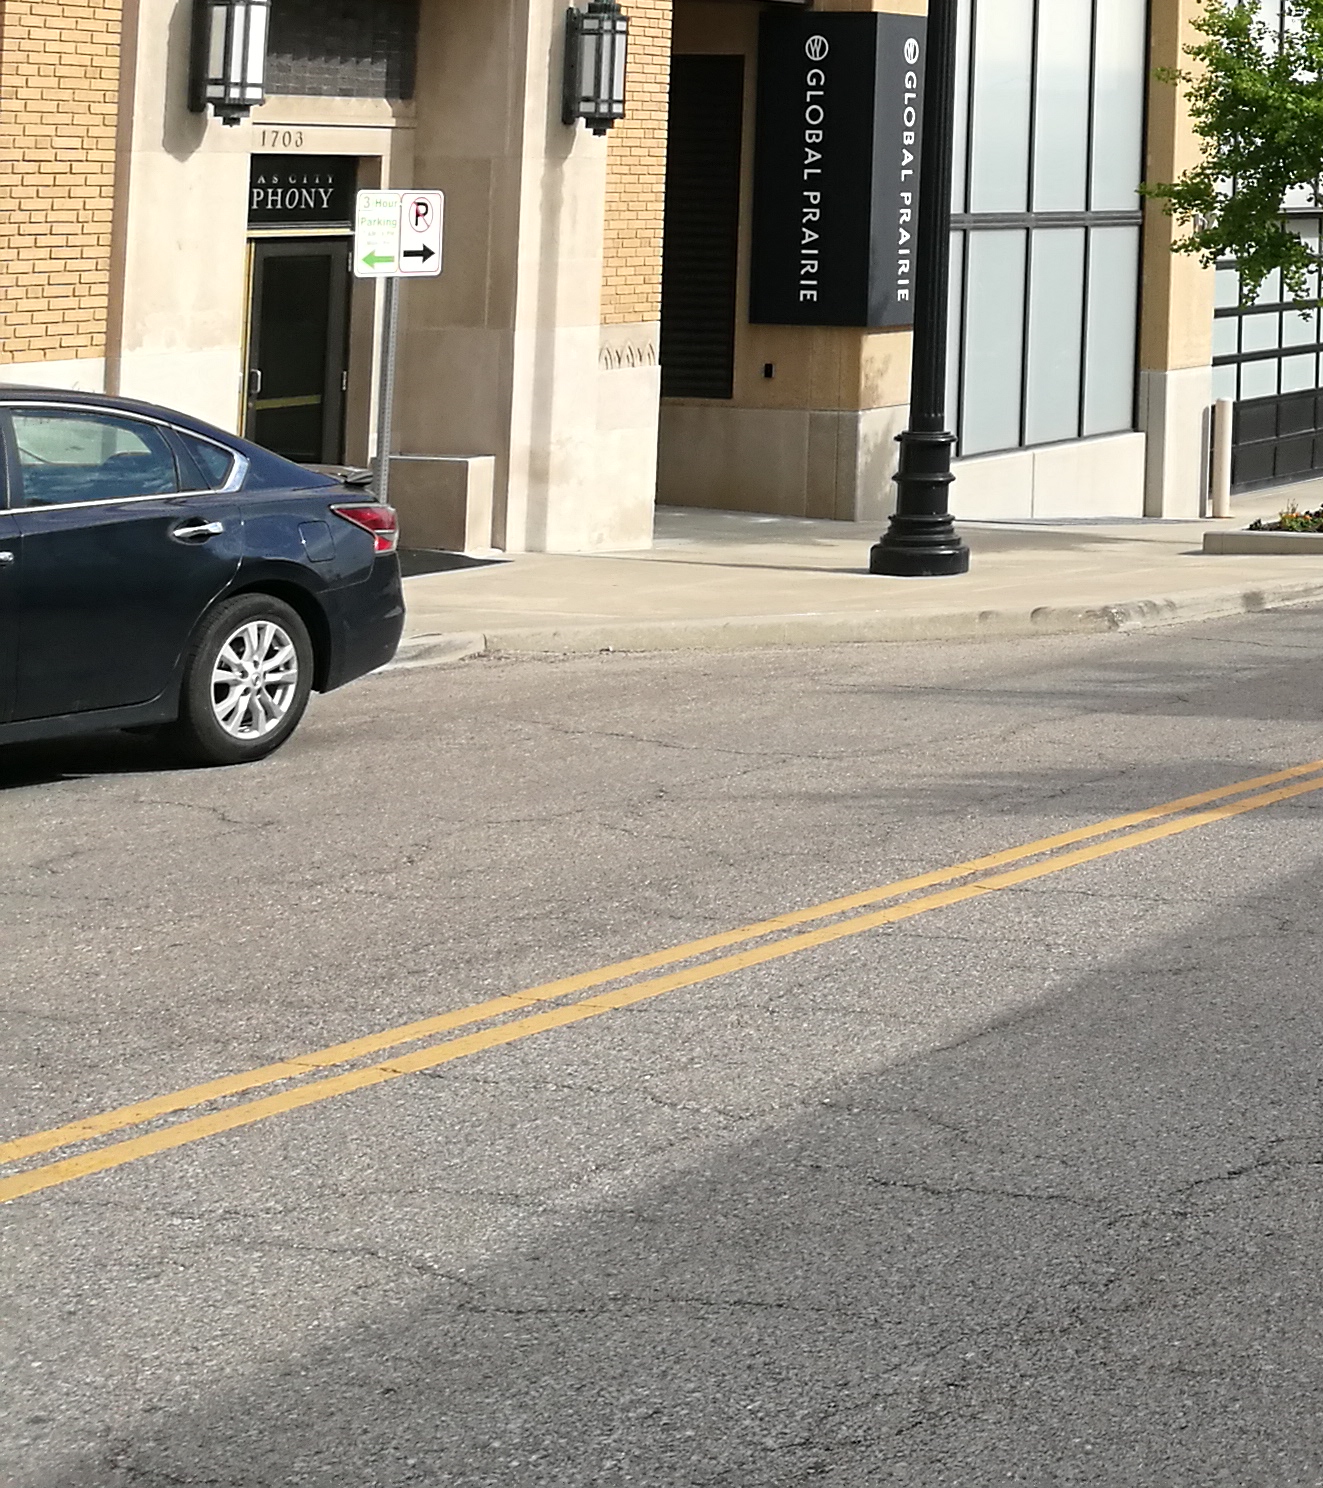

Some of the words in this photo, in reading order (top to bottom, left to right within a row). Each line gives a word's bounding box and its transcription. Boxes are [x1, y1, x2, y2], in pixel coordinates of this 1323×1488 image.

[804, 68, 825, 181] GLOBAL
[900, 71, 918, 182] GLOBAL
[261, 129, 304, 148] 1703
[288, 174, 334, 184] CITY
[251, 187, 334, 210] PHONY
[363, 196, 371, 209] 3
[375, 198, 398, 208] Hour
[360, 217, 398, 229] Parking
[799, 191, 821, 302] PRAIRIE
[896, 191, 912, 301] PRAIRIE
